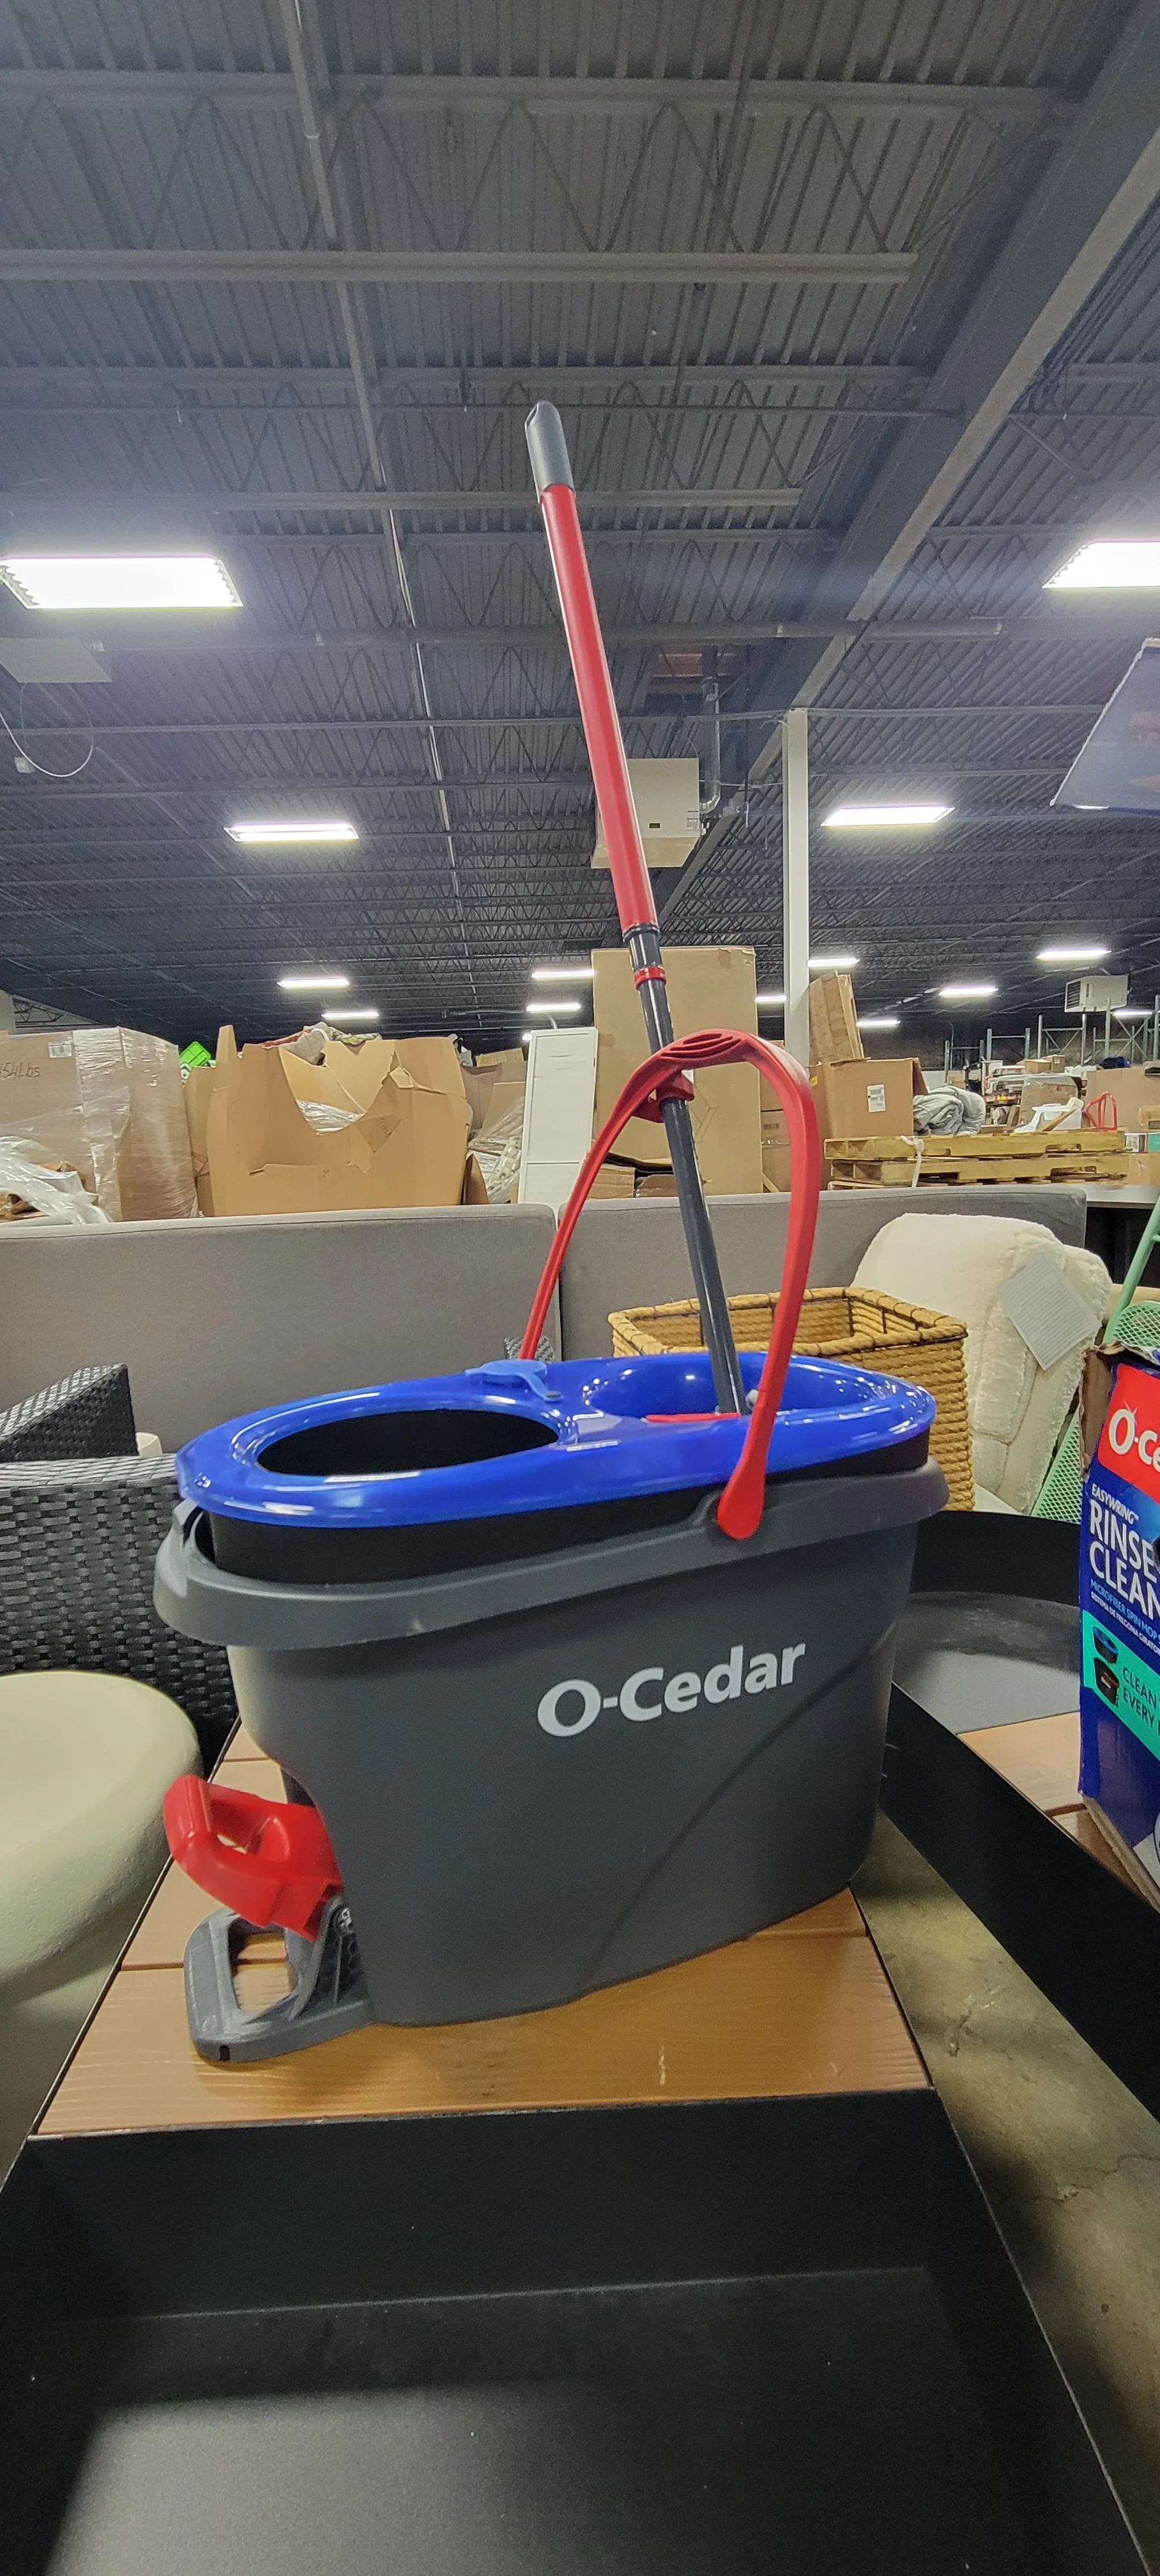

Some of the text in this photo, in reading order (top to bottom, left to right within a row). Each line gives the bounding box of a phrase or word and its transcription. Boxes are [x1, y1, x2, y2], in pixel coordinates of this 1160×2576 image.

[1090, 1498, 1157, 1584] RINSE
[1090, 1540, 1160, 1620] CLEAN
[1091, 1577, 1126, 1616] MICROFIBER
[1126, 1607, 1141, 1629] SPIN
[1141, 1620, 1157, 1641] MOP
[537, 1642, 806, 1737] O-Cedar
[1123, 1666, 1157, 1710] CLEAN
[1123, 1685, 1156, 1728] EVERY
